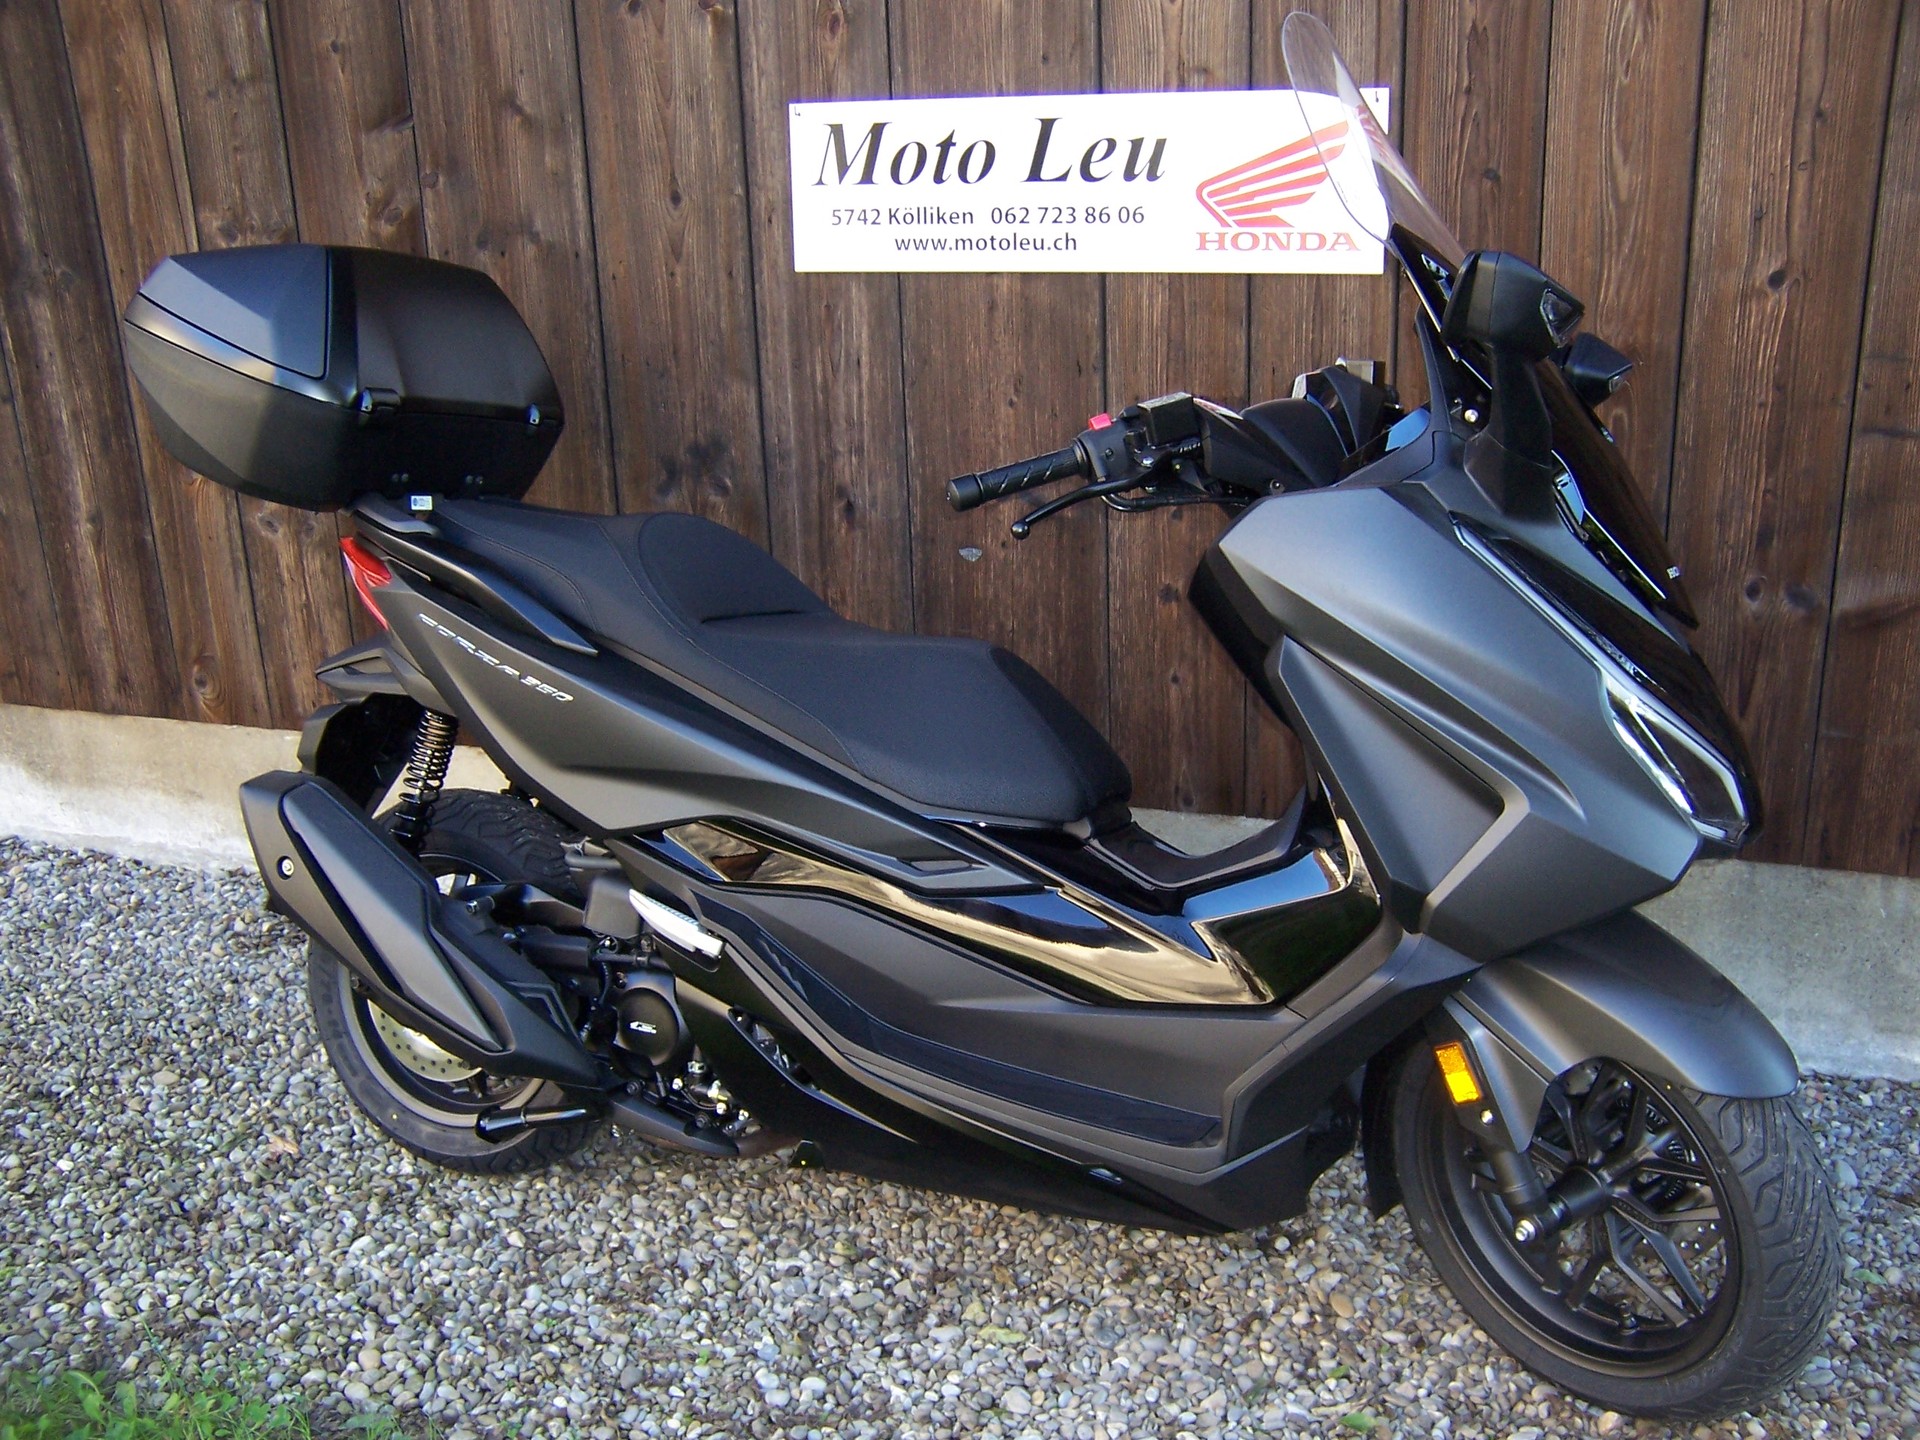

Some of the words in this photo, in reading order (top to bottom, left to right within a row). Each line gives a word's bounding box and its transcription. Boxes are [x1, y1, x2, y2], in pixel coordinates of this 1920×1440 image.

[812, 121, 996, 186] Moto
[1021, 117, 1168, 183] Leu
[832, 207, 881, 226] 5742
[888, 205, 974, 226] Kölliken
[990, 207, 1030, 225] 062
[1037, 206, 1077, 225] 723
[1084, 206, 1111, 225] 86
[1118, 206, 1145, 225] 06
[894, 231, 1077, 252] www.motoleu.ch
[1196, 231, 1361, 252] HONDA
